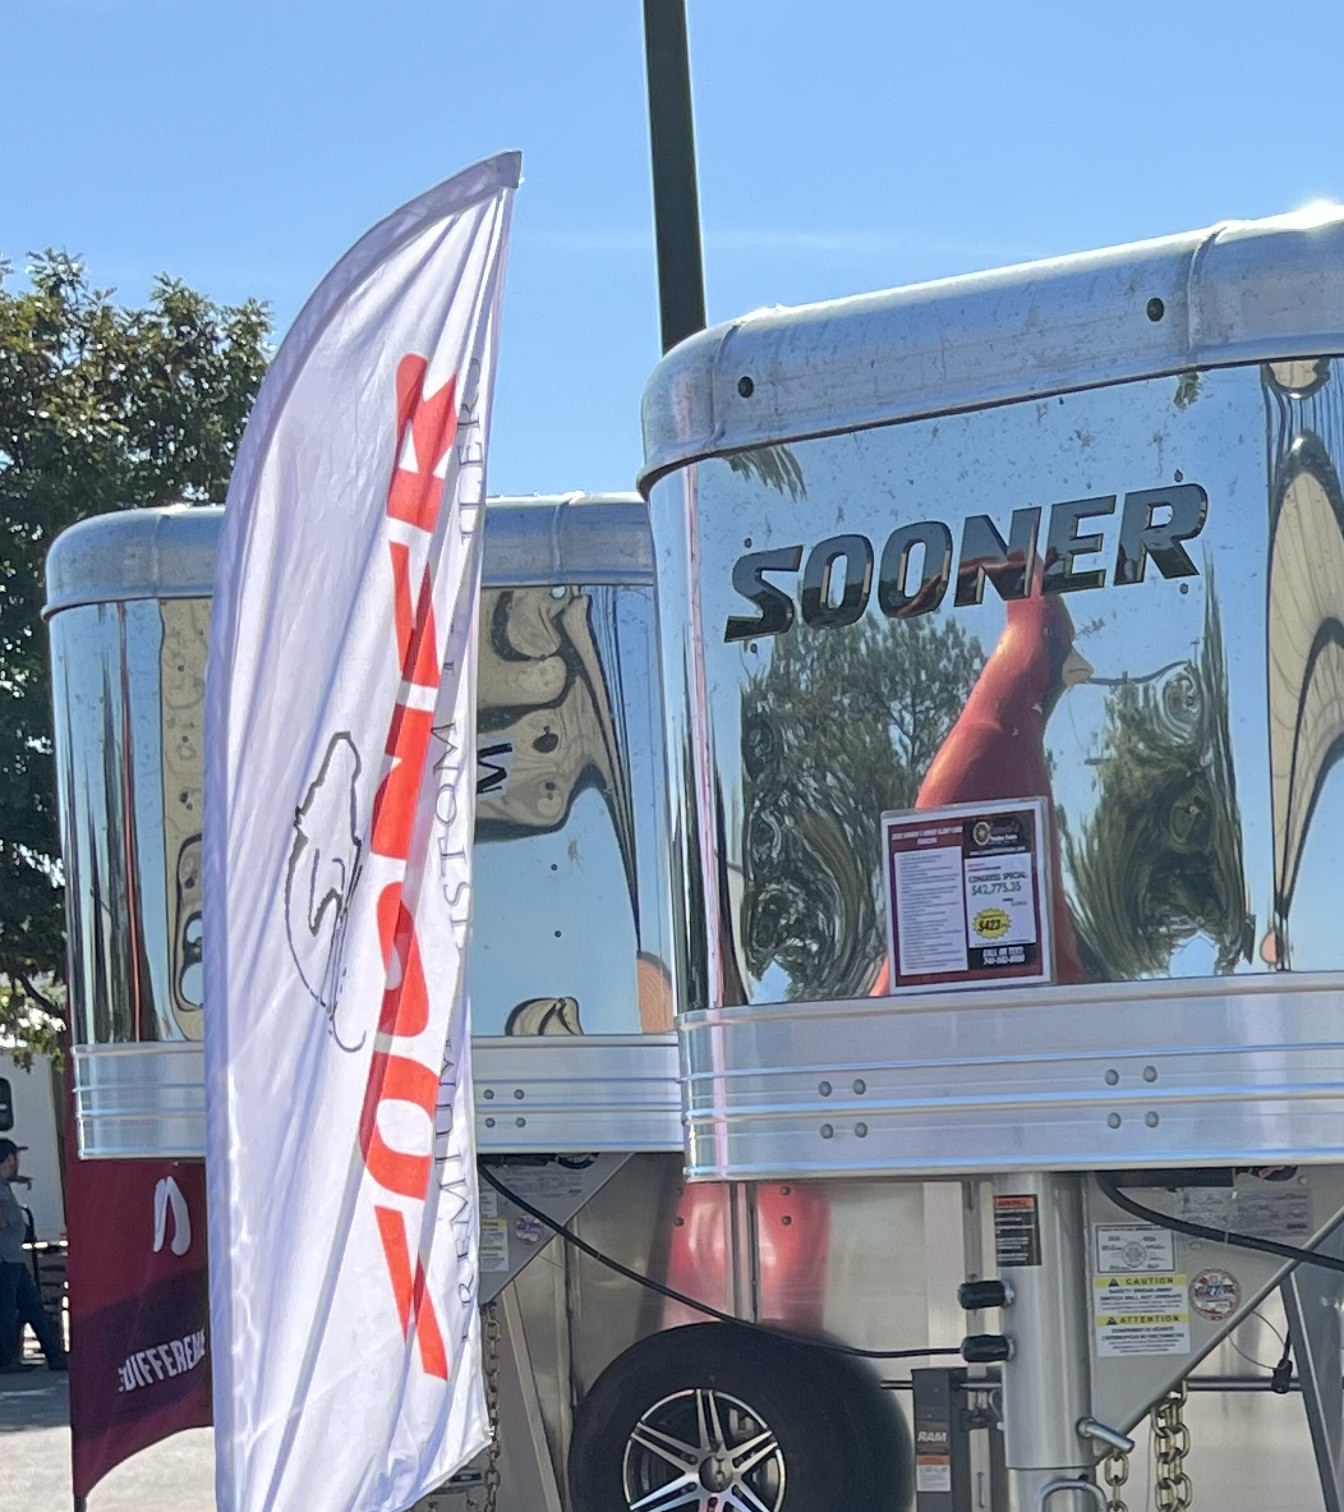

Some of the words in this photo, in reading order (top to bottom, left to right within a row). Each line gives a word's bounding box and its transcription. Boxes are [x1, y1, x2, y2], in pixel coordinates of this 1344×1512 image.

[723, 482, 1209, 643] SOONER
[1126, 1276, 1174, 1285] CAUTION
[1120, 1315, 1180, 1324] ATTENTION
[917, 1431, 948, 1443] RAM
